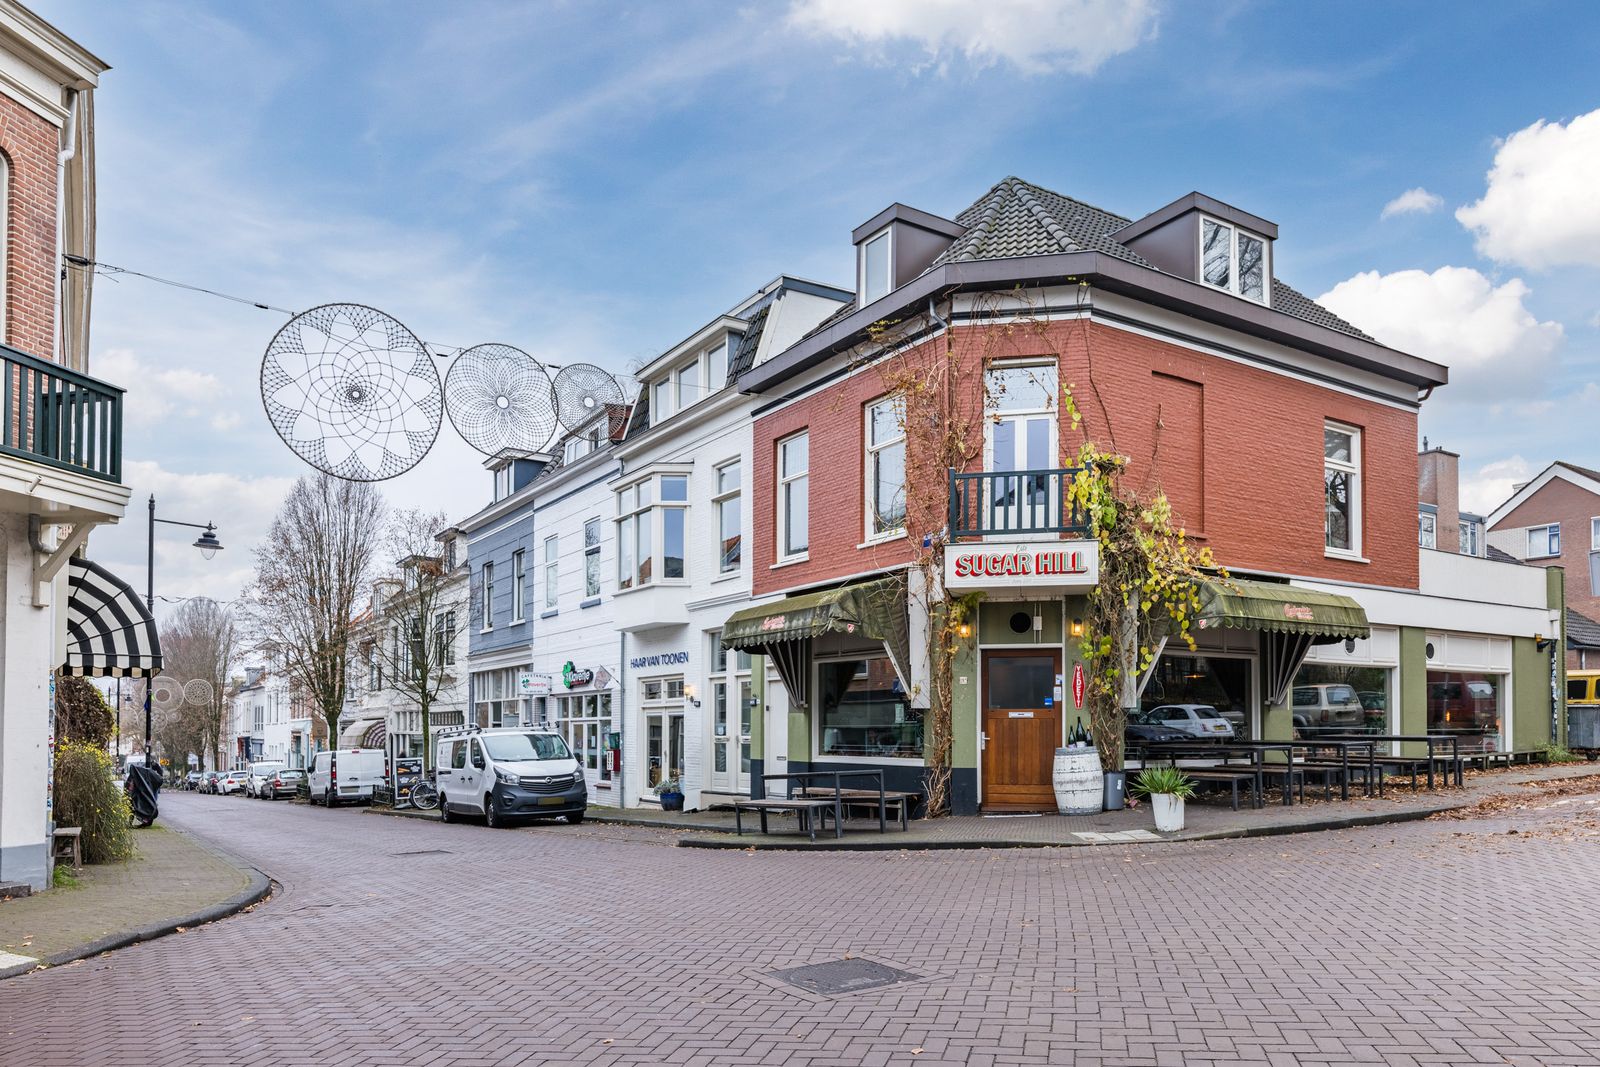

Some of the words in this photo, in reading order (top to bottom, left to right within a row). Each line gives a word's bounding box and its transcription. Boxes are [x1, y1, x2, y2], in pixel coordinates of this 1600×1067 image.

[955, 552, 1032, 577] SUGAR
[1035, 551, 1089, 575] HILL
[631, 656, 646, 669] HAAR
[647, 654, 660, 667] VAN
[661, 651, 689, 665] TOONEN
